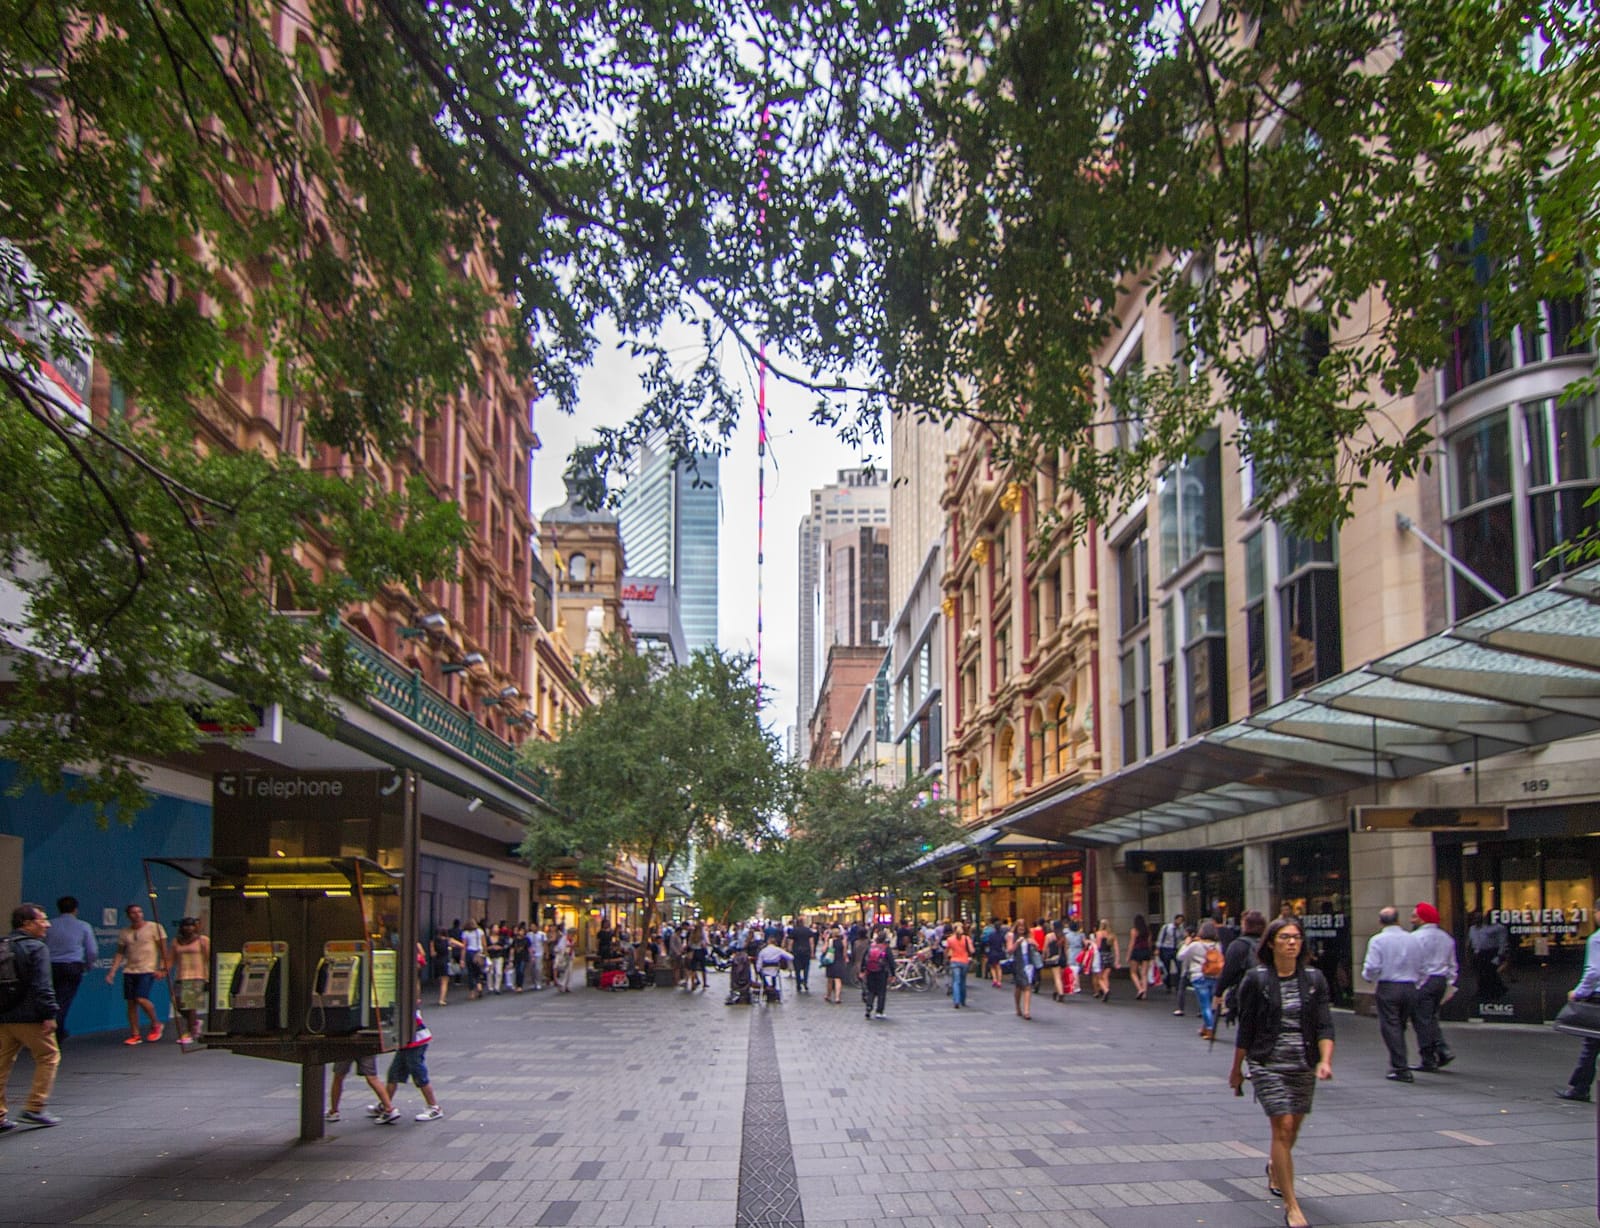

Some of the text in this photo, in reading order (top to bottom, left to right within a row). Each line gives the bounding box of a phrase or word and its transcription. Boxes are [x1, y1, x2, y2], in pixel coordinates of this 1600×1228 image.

[621, 583, 658, 601] tfield
[245, 775, 343, 799] Telephone
[1521, 779, 1549, 793] 189
[1298, 913, 1333, 928] OREVER
[1491, 907, 1588, 924] FOREVER 21
[1510, 924, 1577, 934] COMING SOON
